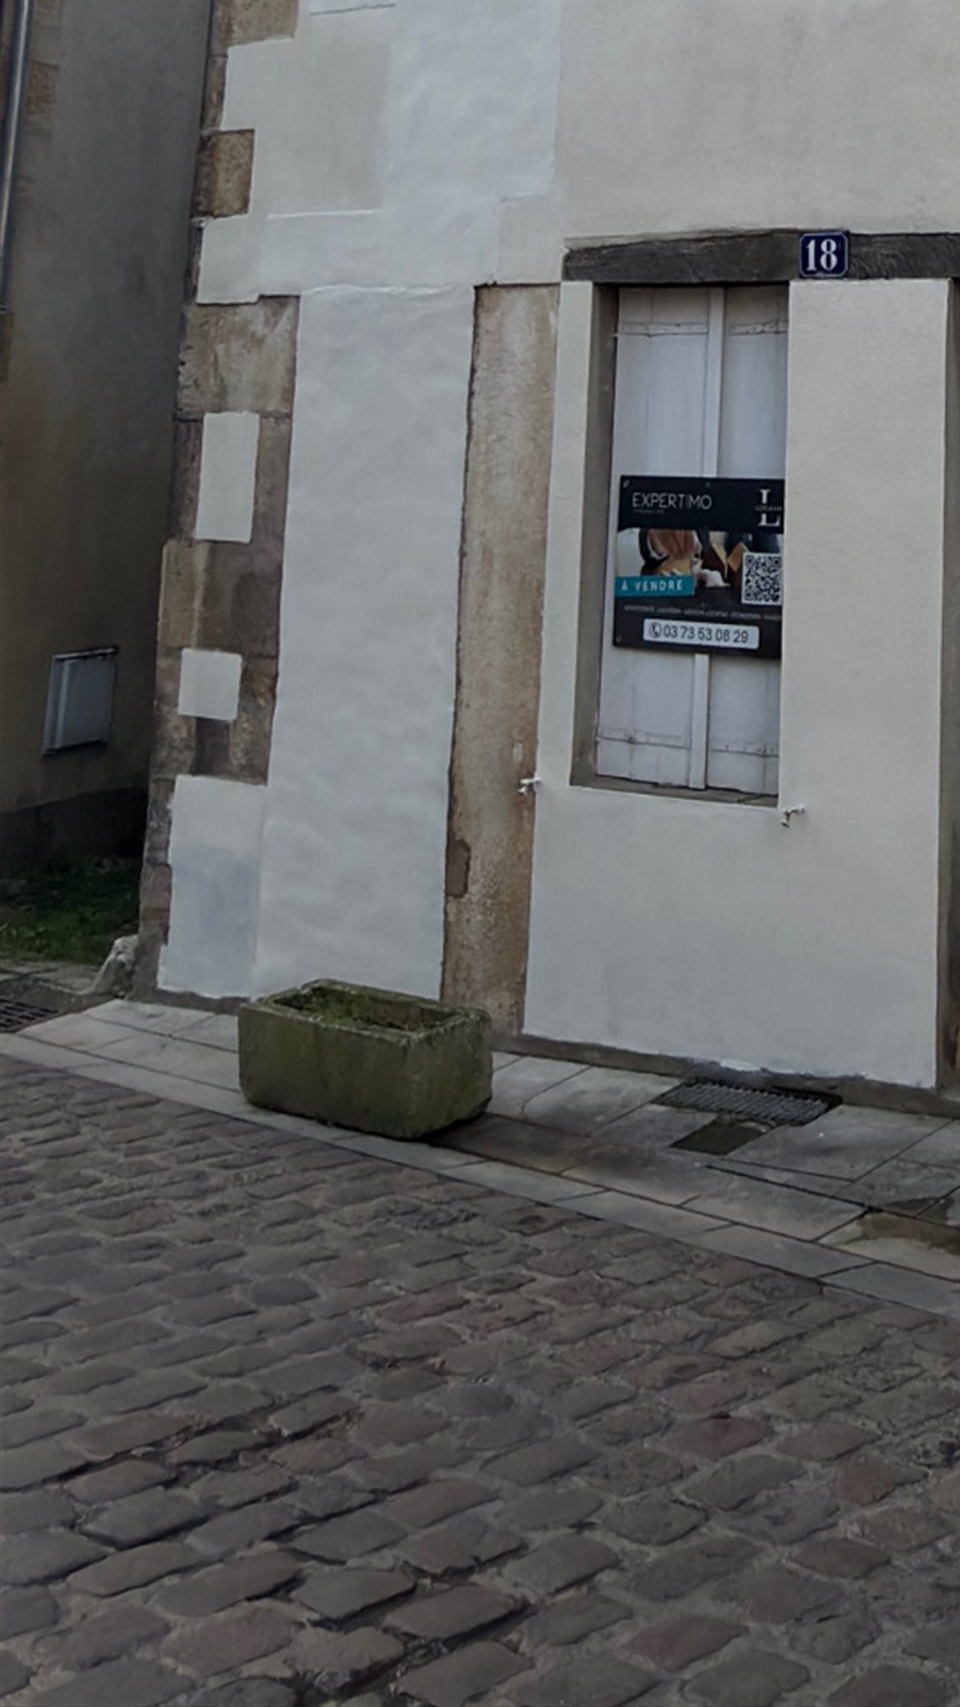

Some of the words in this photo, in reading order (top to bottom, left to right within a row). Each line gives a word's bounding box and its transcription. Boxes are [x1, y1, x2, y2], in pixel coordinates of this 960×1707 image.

[805, 238, 838, 272] 18
[632, 492, 713, 510] EXPERTIMO
[634, 579, 684, 592] VENDRE
[663, 624, 678, 638] 03
[680, 626, 695, 640] 73
[699, 627, 713, 641] 53
[733, 629, 749, 644] 29
